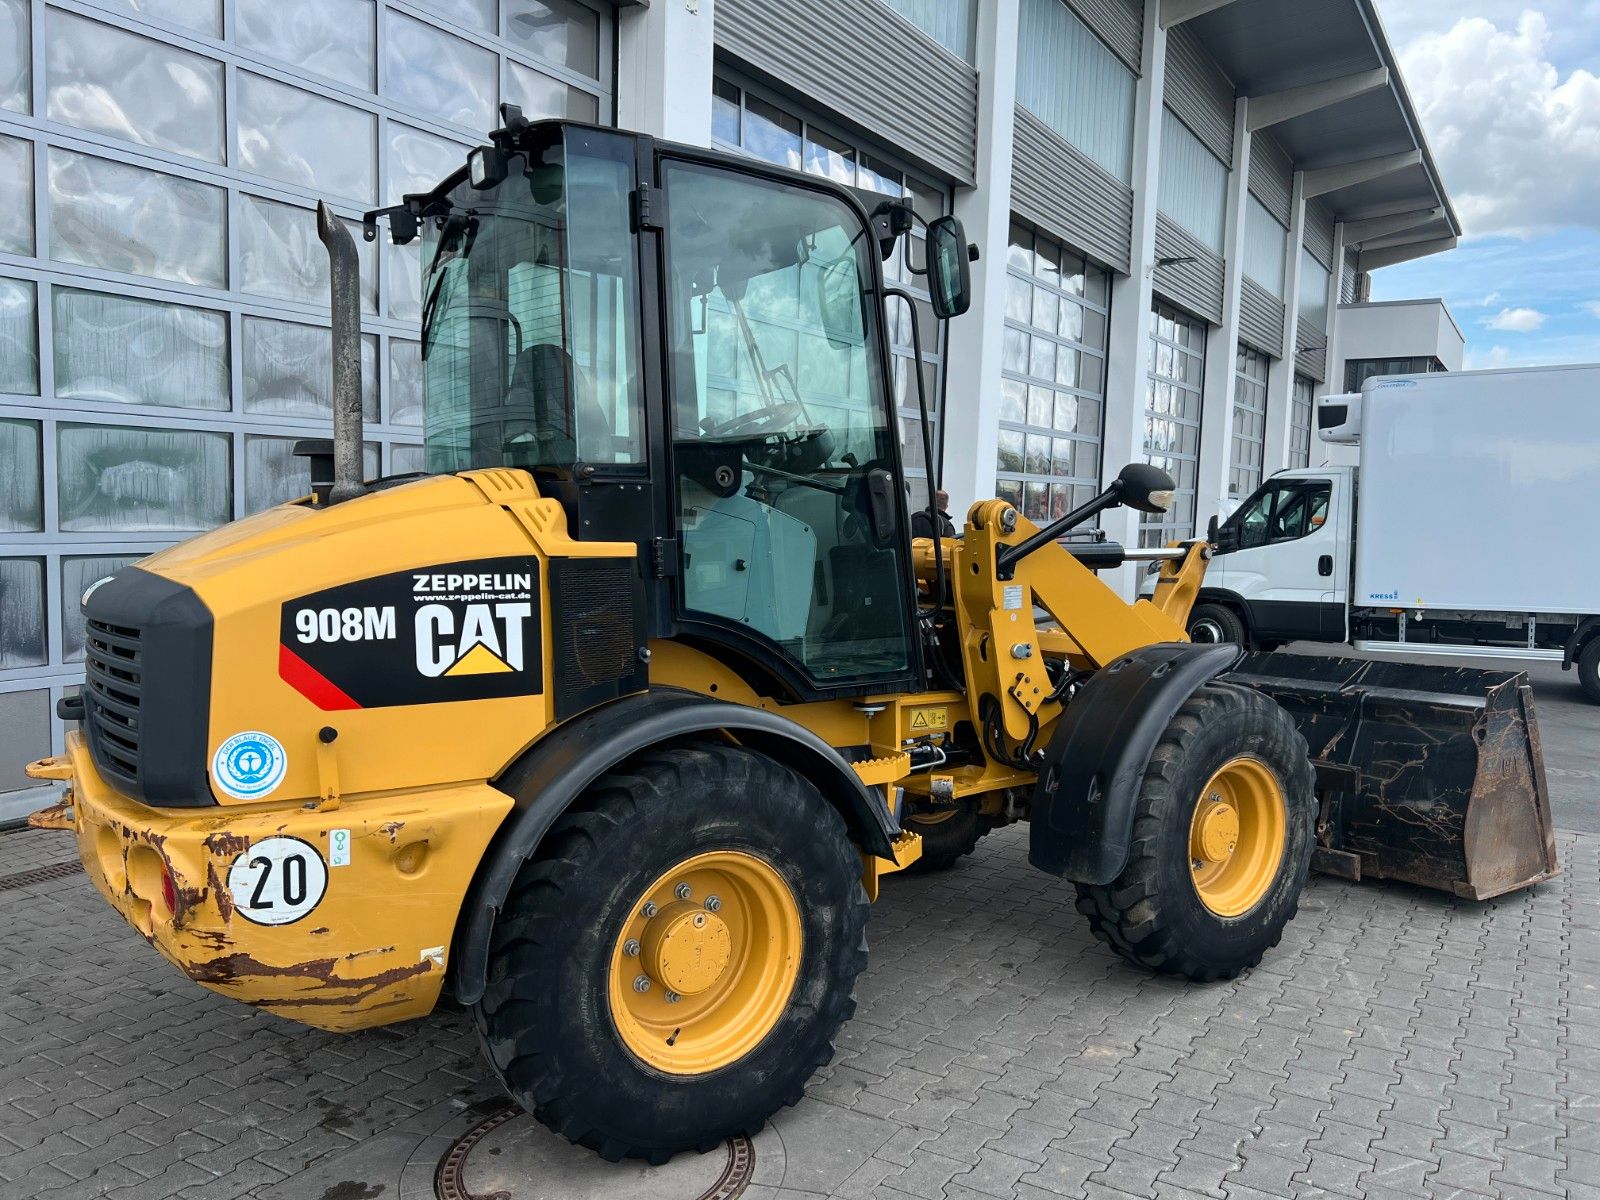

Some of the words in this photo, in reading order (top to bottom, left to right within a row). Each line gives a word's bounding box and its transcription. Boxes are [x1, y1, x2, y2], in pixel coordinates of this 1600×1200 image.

[413, 574, 531, 591] ZEPPELIN
[295, 606, 396, 643] 908M
[415, 602, 531, 677] CAT
[234, 735, 257, 744] BLAUE
[249, 854, 306, 909] 20
